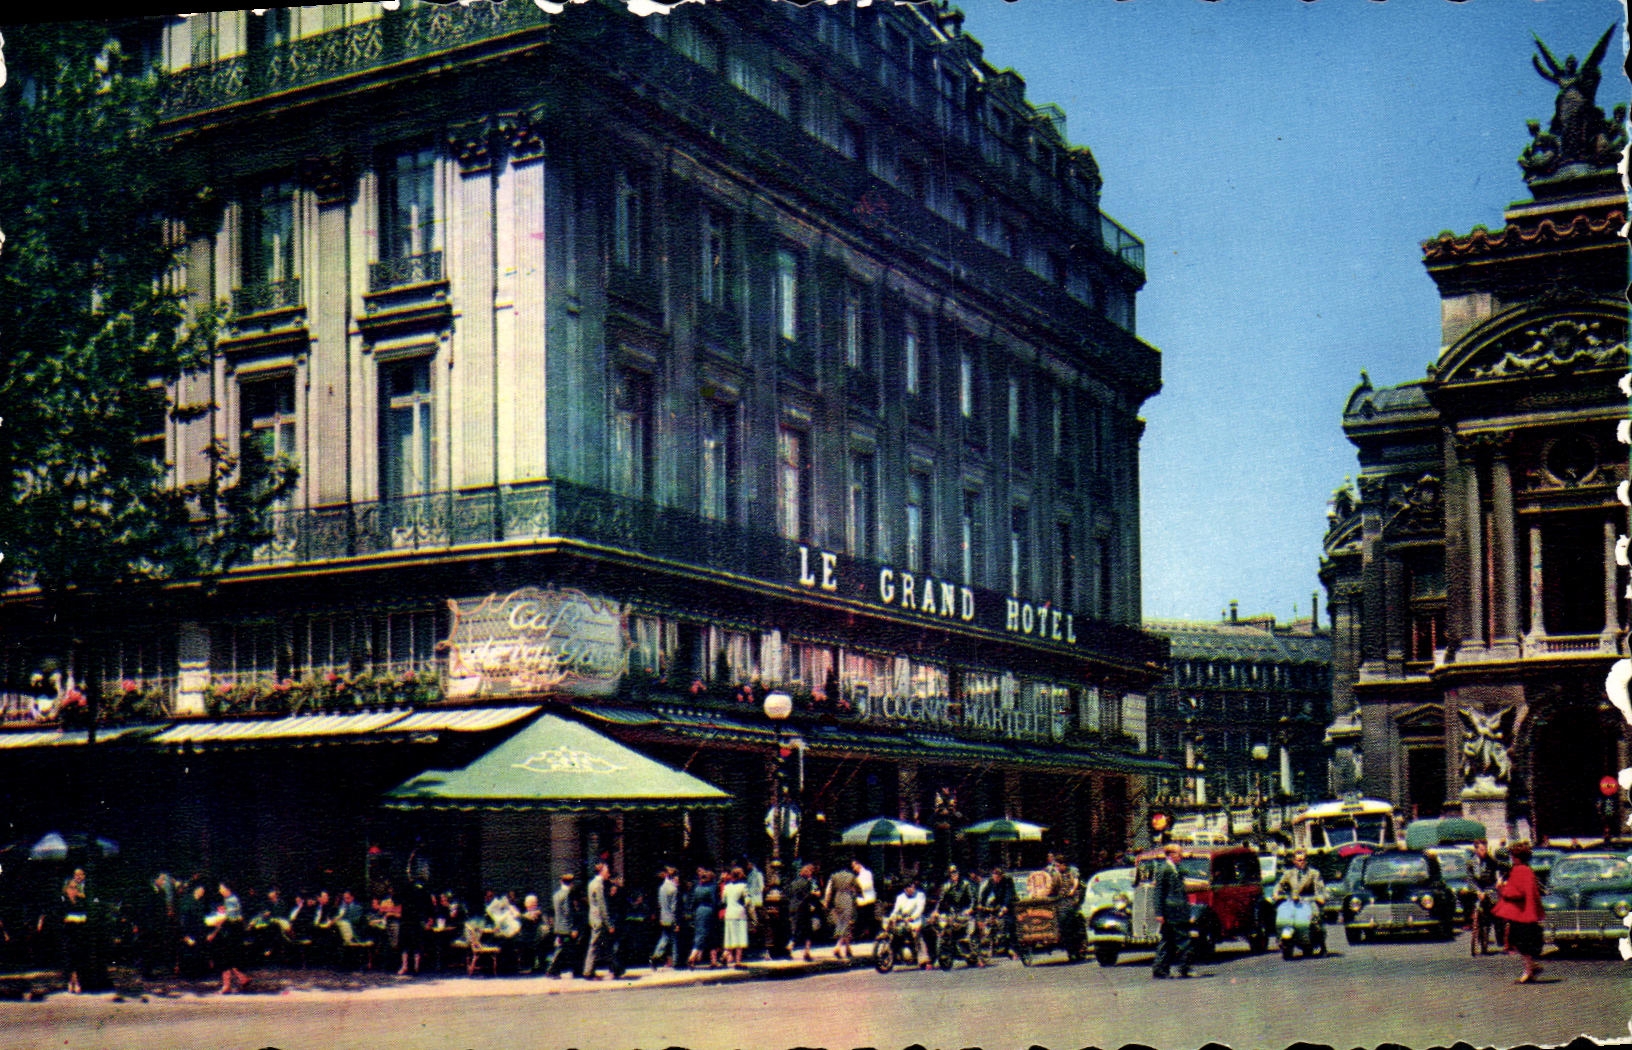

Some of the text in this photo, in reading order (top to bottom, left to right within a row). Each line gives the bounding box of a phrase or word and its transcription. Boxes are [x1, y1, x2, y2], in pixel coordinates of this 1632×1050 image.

[799, 546, 1076, 644] LE GRAND HOTEL
